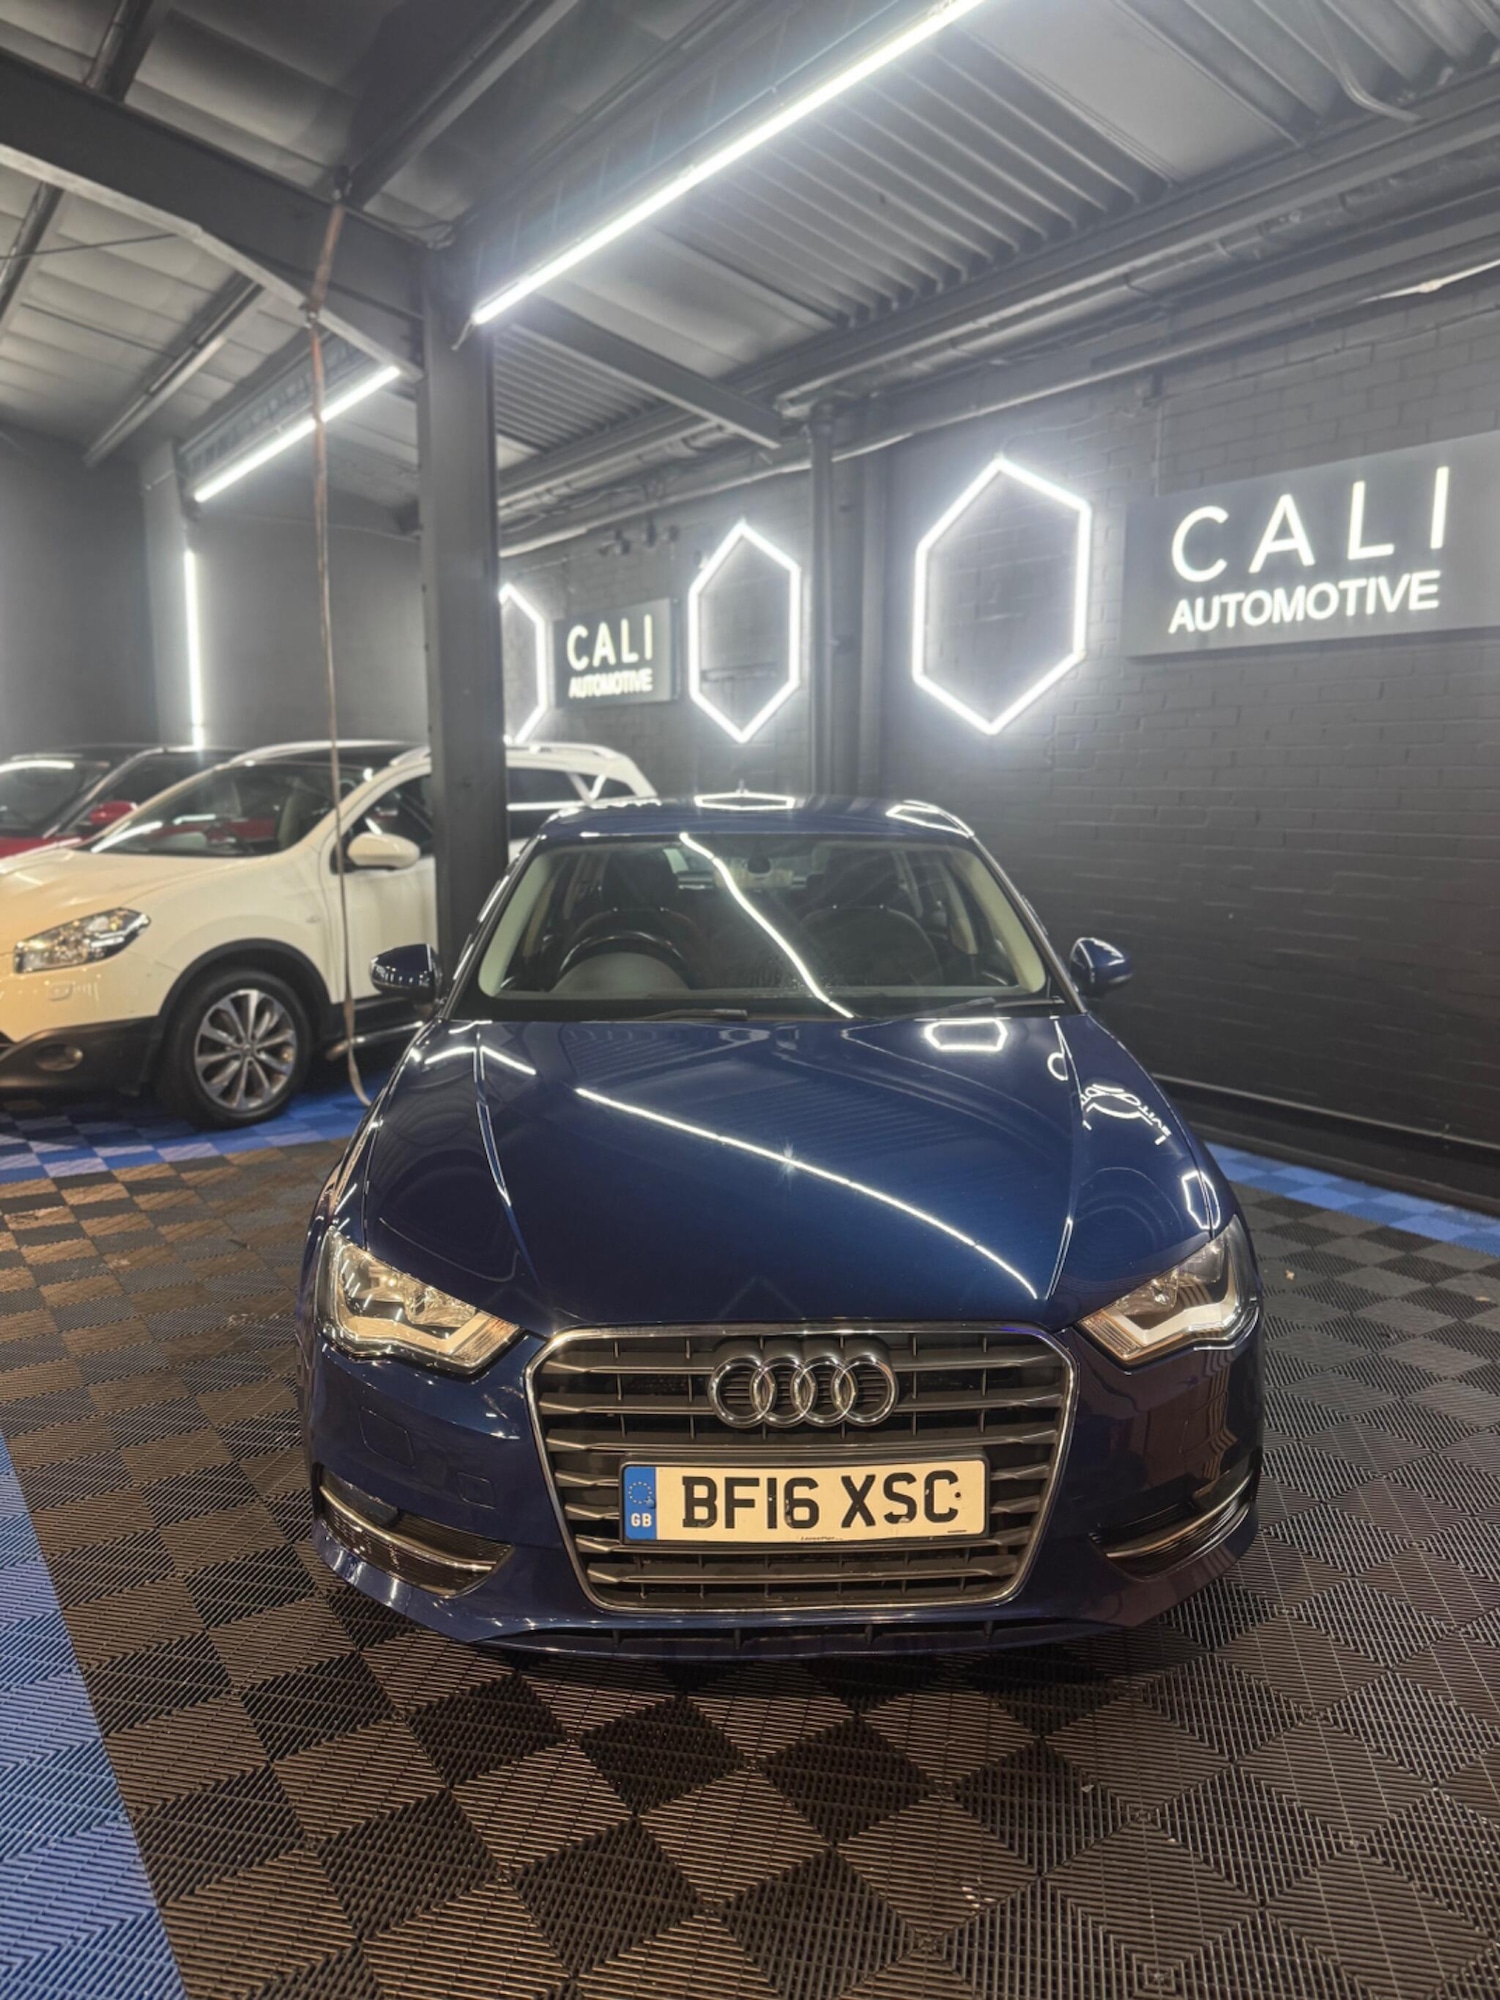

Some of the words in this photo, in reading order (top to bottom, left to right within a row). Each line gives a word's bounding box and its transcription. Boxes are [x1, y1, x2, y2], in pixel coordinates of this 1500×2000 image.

[1171, 466, 1449, 582] CALI
[1168, 570, 1441, 634] AUTOMOTIVE
[567, 614, 652, 671] CALI
[568, 667, 653, 698] AUTOMOTIVE
[631, 1512, 652, 1527] GB
[682, 1475, 820, 1529] BF16
[840, 1470, 959, 1528] XSC
